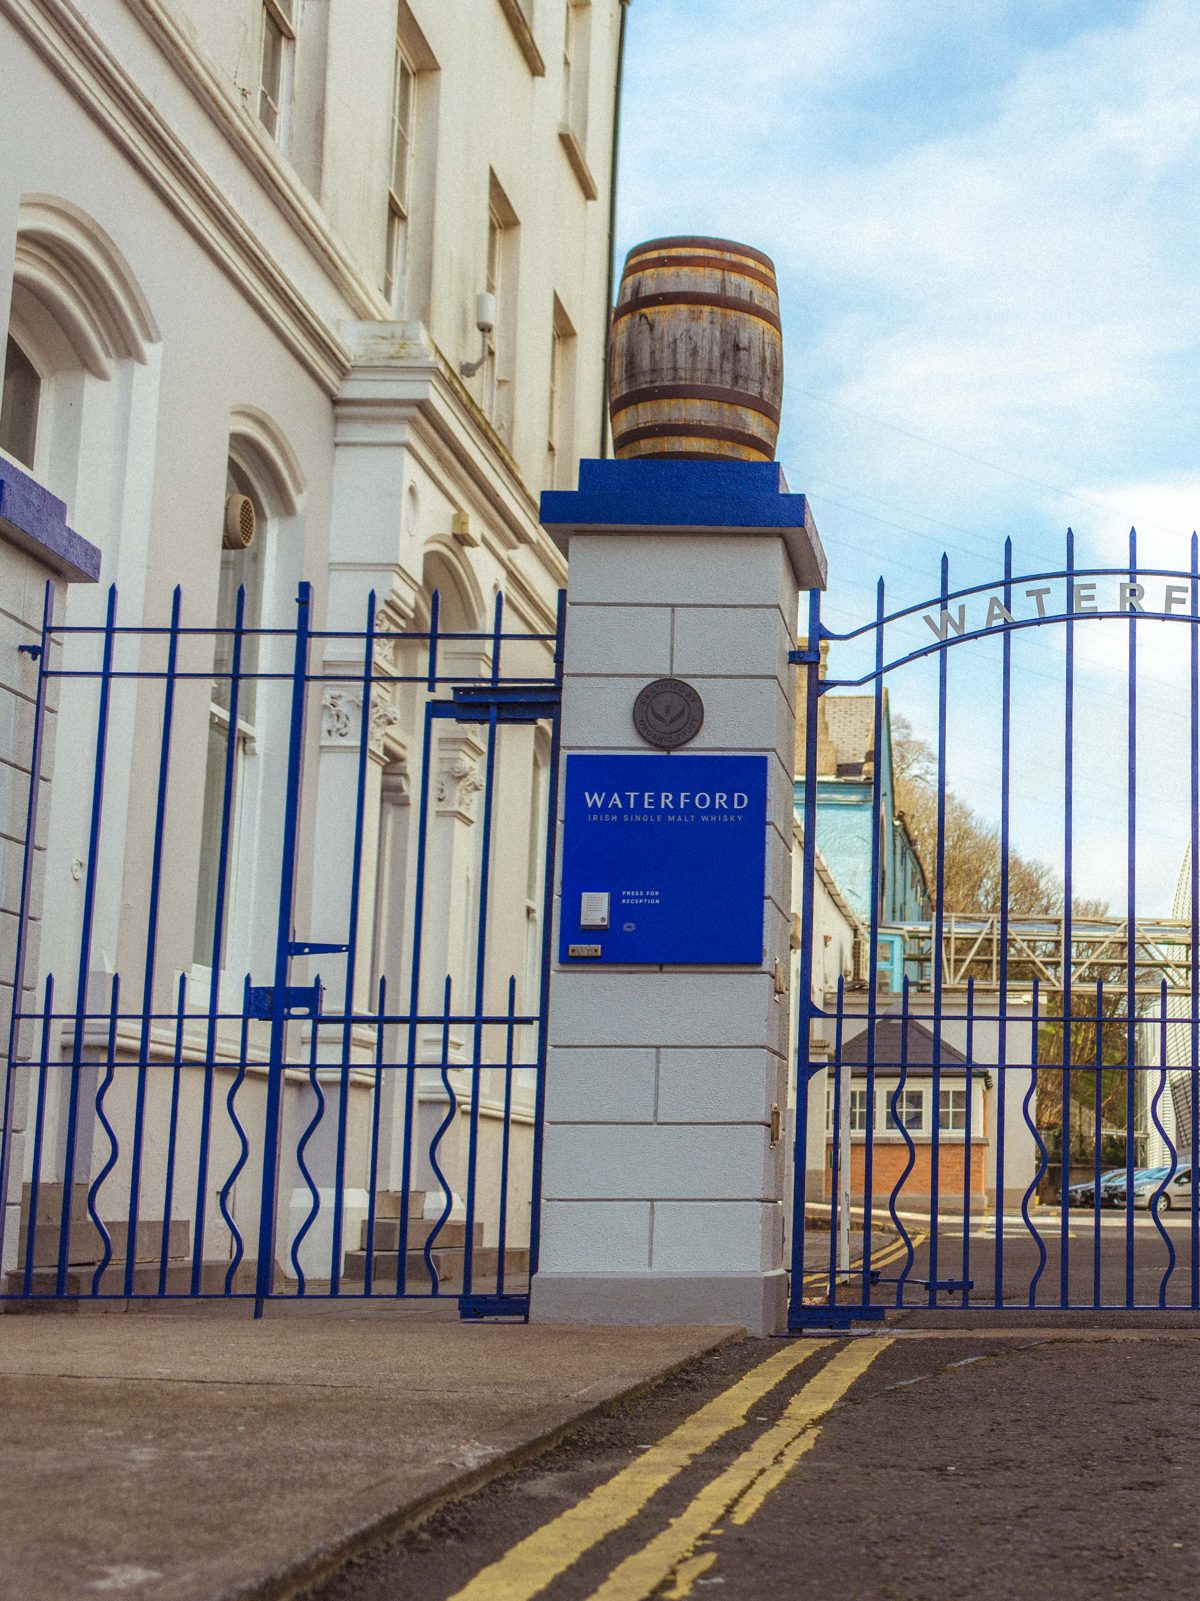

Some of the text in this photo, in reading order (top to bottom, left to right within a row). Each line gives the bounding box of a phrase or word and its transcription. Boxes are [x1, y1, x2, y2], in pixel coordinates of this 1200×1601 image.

[584, 791, 749, 809] WATERFORD
[588, 814, 743, 822] IRISH SINGLE MALT WHISKY
